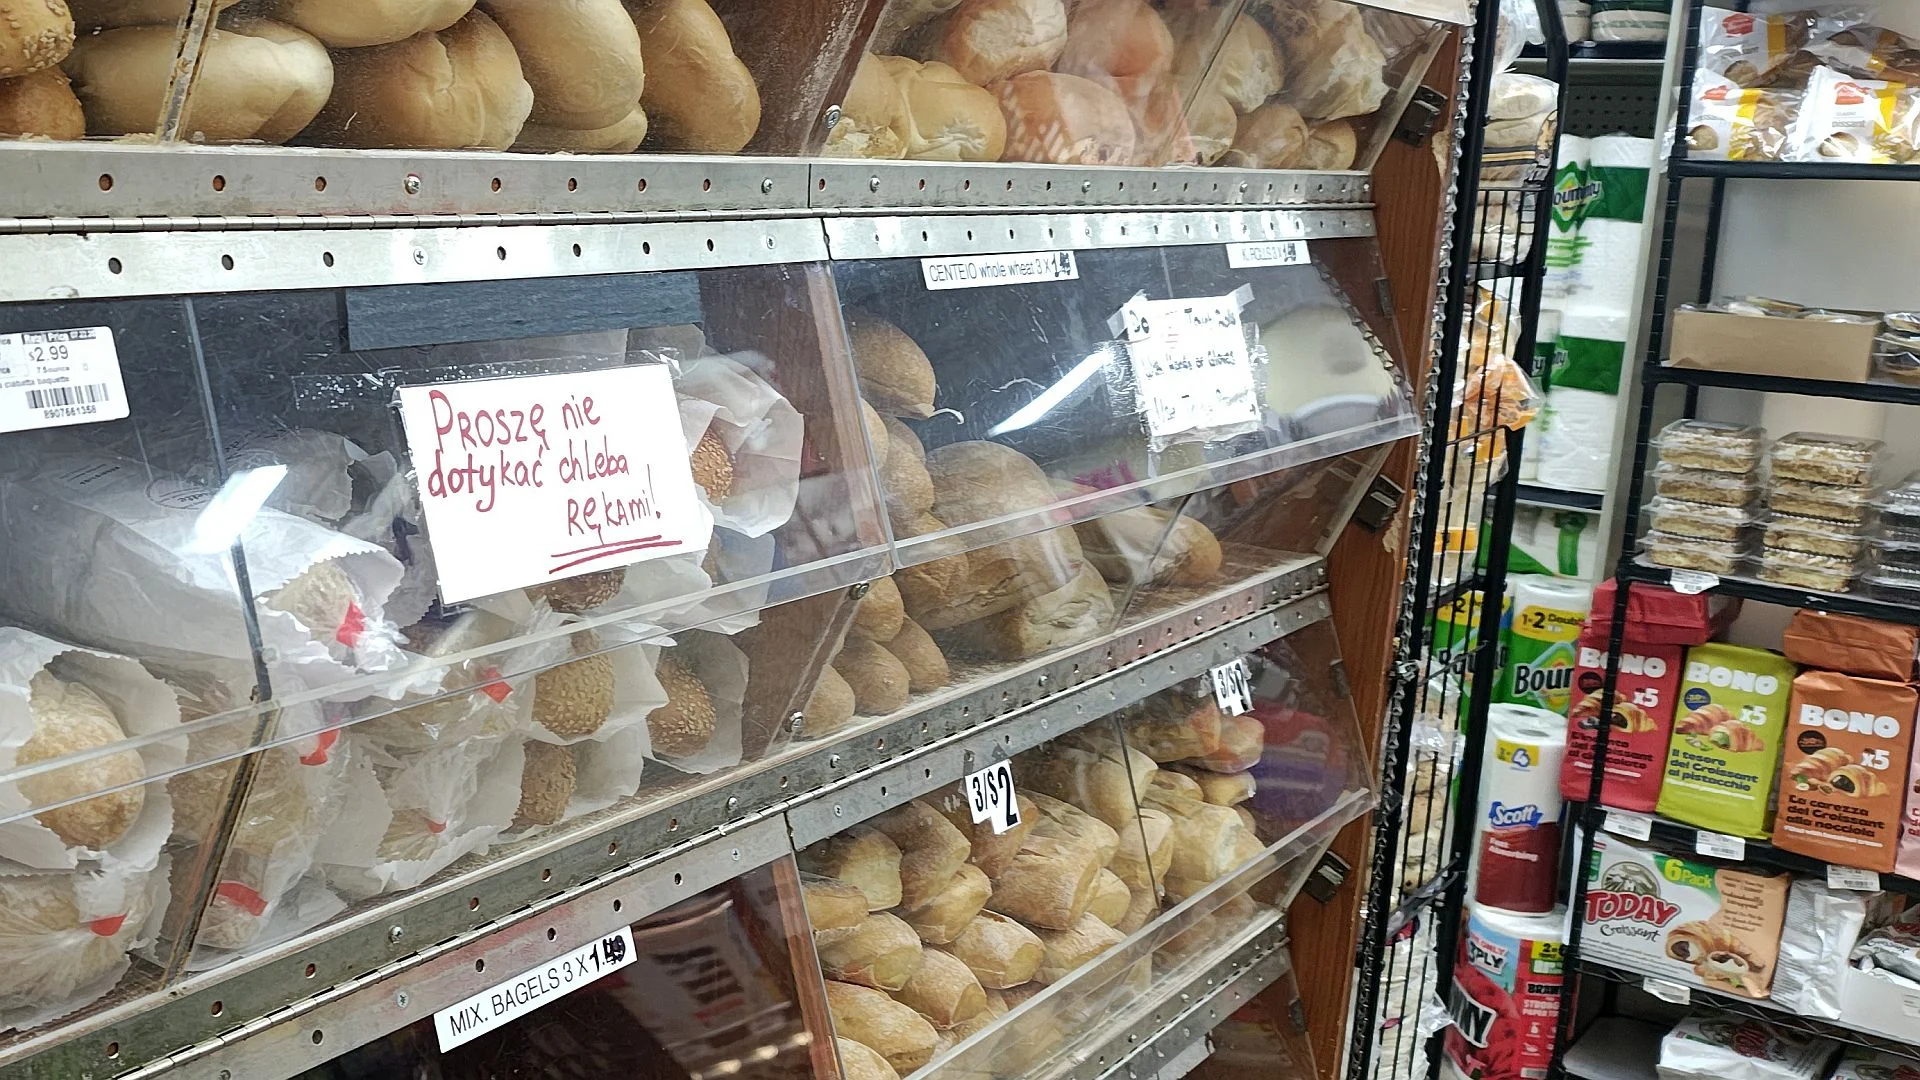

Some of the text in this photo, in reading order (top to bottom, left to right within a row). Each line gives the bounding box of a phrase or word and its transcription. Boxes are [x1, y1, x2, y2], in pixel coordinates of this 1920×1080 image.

[929, 262, 977, 282] CENTEIO
[979, 260, 1007, 279] whole
[1008, 260, 1035, 277] wheat
[1036, 257, 1043, 274] 3
[28, 344, 69, 362] $2.99
[562, 394, 601, 430] nie
[427, 434, 630, 513] dotykać chleba
[1686, 661, 1779, 696] BONO
[1632, 687, 1659, 708] x5
[1739, 704, 1768, 726] x5
[1799, 703, 1901, 739] BONO
[1682, 751, 1727, 767] tesoro
[1860, 749, 1891, 771] x5
[1668, 769, 1752, 792] al pistacchio
[1670, 759, 1759, 783] del Croissant
[972, 765, 1019, 828] 3/$2
[1809, 799, 1869, 817] carezza
[1489, 804, 1536, 827] Scott
[1785, 815, 1876, 838] alla nocciola
[1787, 804, 1886, 830] del Croissant
[1584, 891, 1678, 926] TODAY
[1600, 924, 1661, 943] Croissant
[449, 1002, 489, 1036] MIX.
[491, 967, 560, 1016] BAGELS
[562, 961, 573, 982] 3
[577, 953, 589, 977] X
